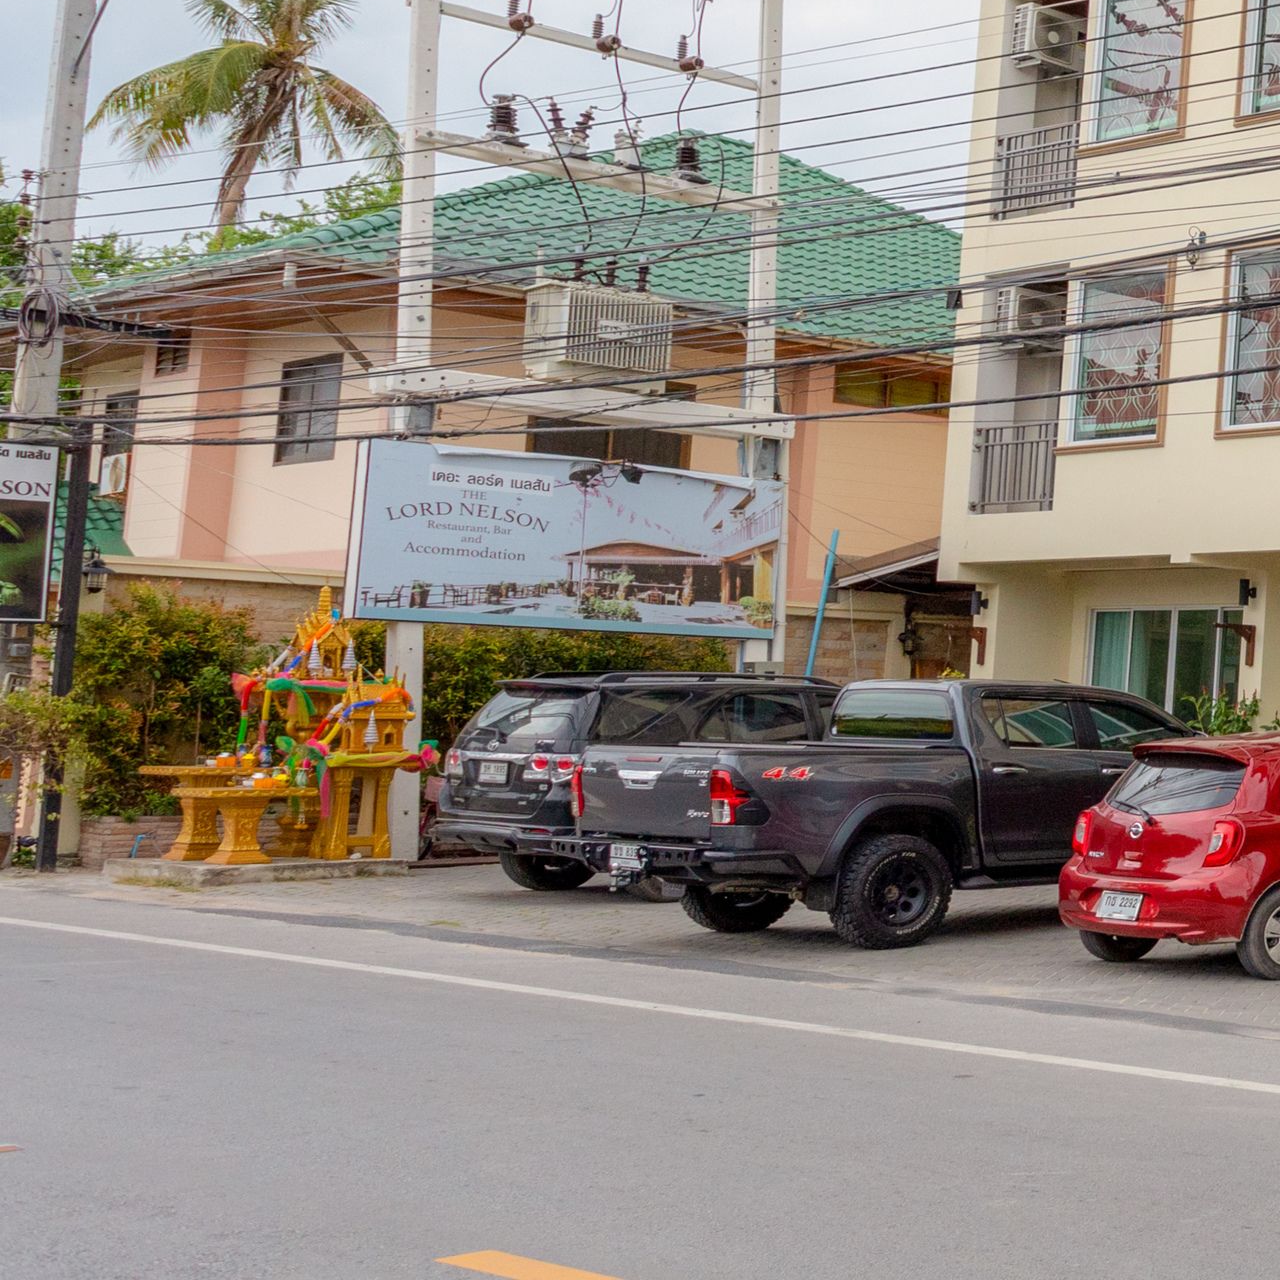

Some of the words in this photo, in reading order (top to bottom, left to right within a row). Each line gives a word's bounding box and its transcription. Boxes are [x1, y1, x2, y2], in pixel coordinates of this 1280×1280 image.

[15, 449, 52, 461] เนลสัน
[0, 480, 53, 498] SON
[432, 470, 460, 483] เดอะ
[467, 473, 504, 488] ลอร์ด
[510, 477, 551, 492] เนลสัน
[461, 490, 488, 501] THE
[385, 501, 453, 521] LORD
[459, 502, 551, 533] NELSON
[427, 520, 491, 534] Restaurant,
[493, 525, 513, 536] Bar
[460, 535, 483, 544] and
[403, 541, 526, 562] Accommodation
[1119, 896, 1138, 909] 2292
